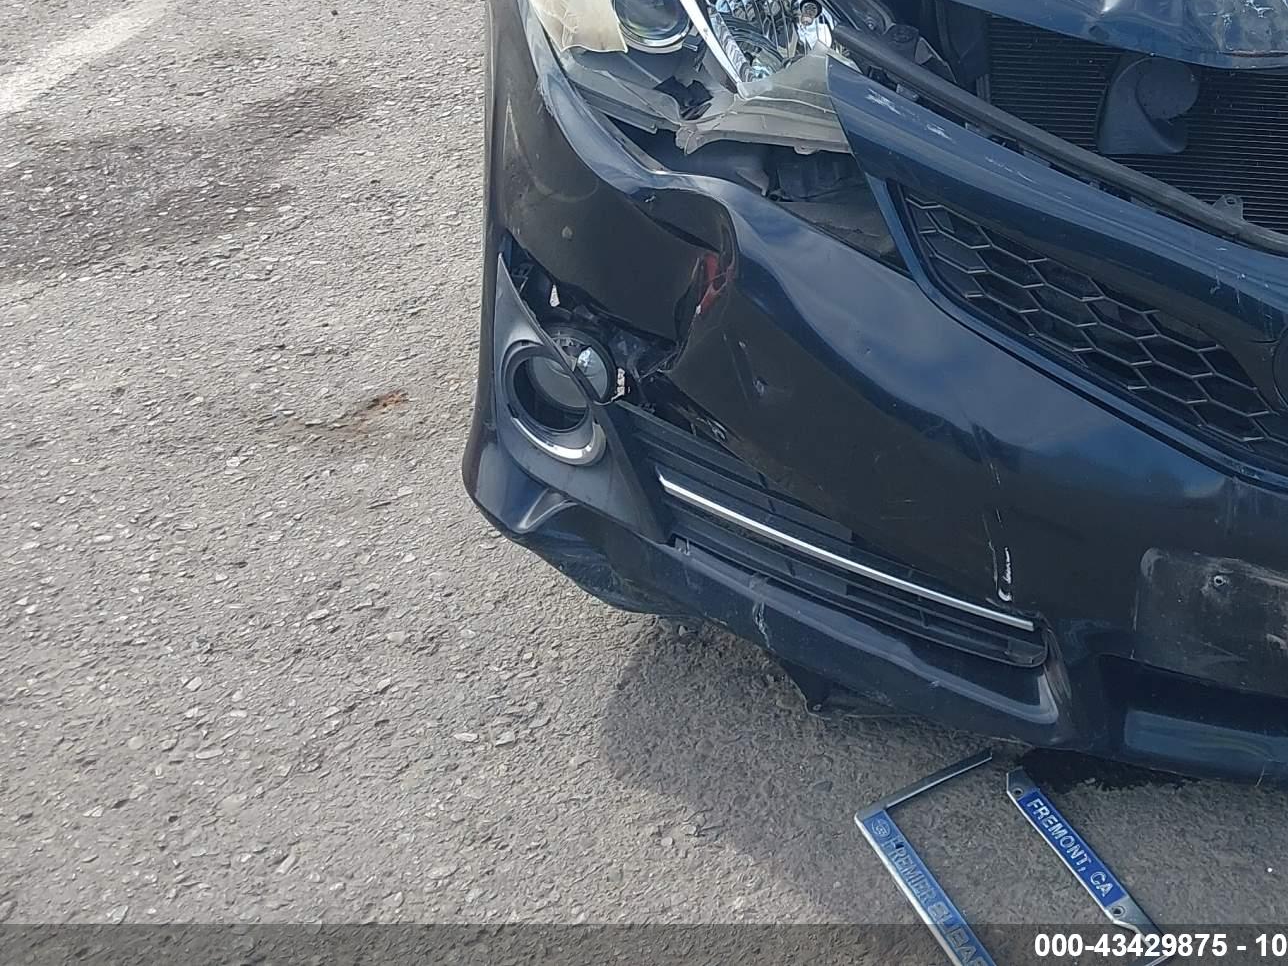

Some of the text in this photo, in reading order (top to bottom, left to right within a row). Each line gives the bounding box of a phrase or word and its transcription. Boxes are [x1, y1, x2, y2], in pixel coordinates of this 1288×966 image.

[882, 835, 938, 905] PREMIER
[1027, 798, 1114, 898] FREMONT, CA
